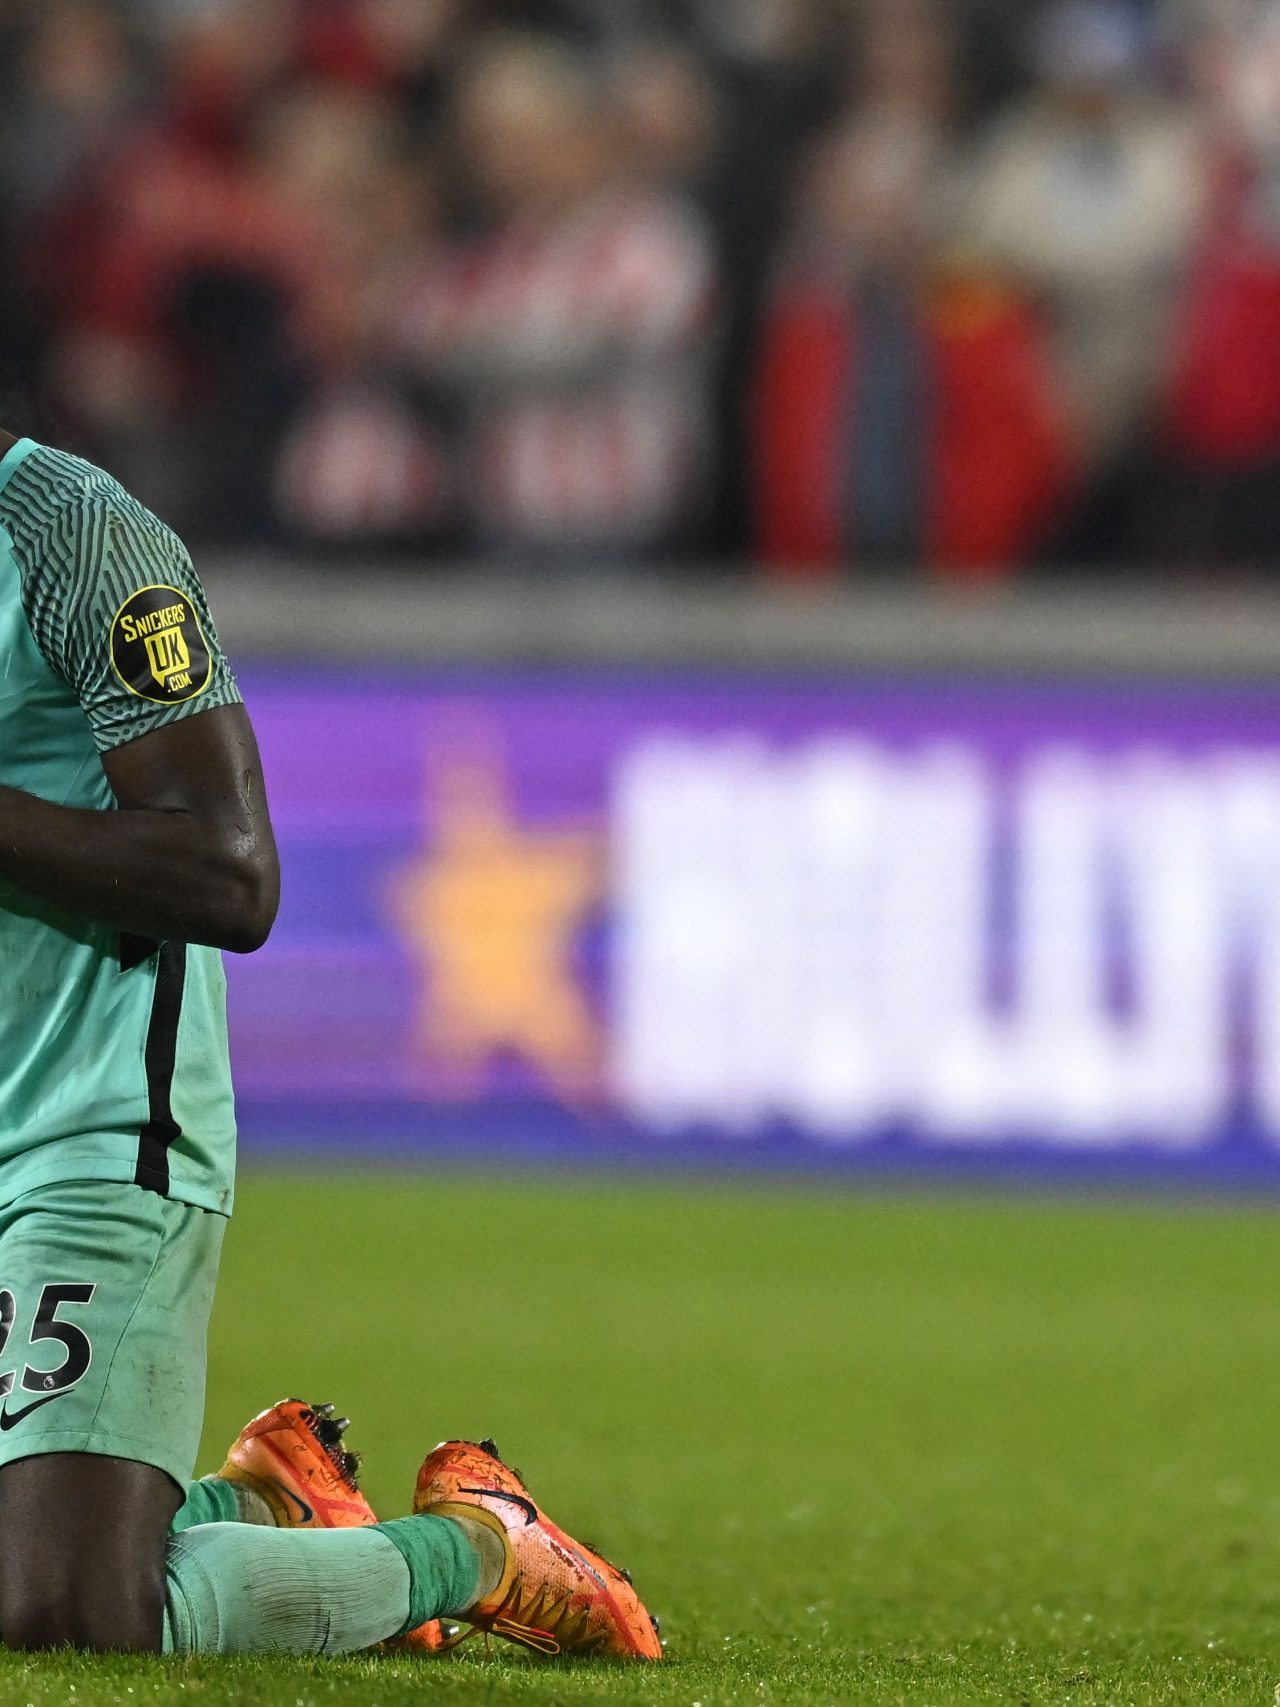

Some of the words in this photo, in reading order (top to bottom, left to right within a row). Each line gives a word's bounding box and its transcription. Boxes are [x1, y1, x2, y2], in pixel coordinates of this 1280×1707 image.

[120, 603, 186, 643] SNICKERS
[150, 630, 185, 673] UK
[167, 672, 193, 693] .COM
